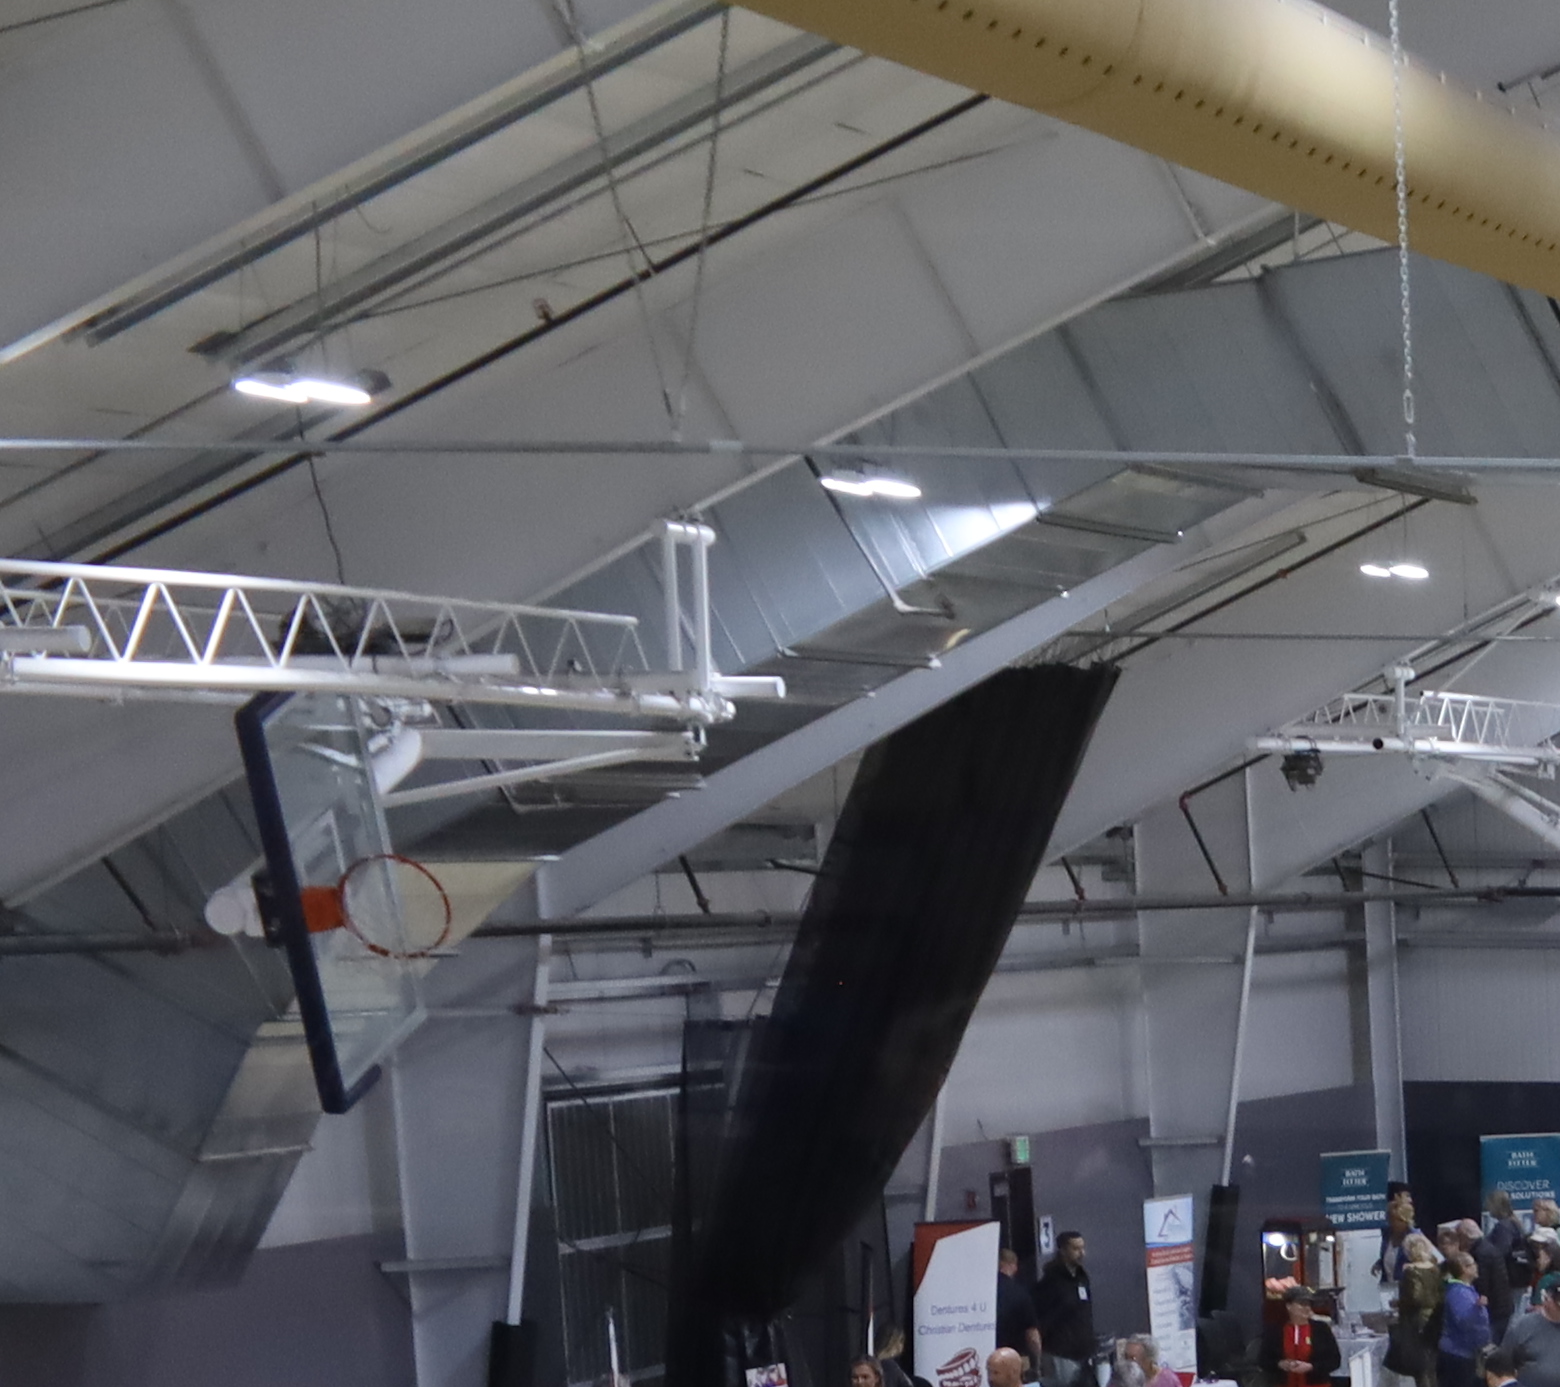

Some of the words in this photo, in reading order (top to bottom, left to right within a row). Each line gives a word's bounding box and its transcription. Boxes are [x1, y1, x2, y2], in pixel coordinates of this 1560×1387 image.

[1496, 1180, 1550, 1190] DISCOVER
[1511, 1191, 1555, 1199] SOLUTIONS
[1347, 1210, 1386, 1222] SHOWER
